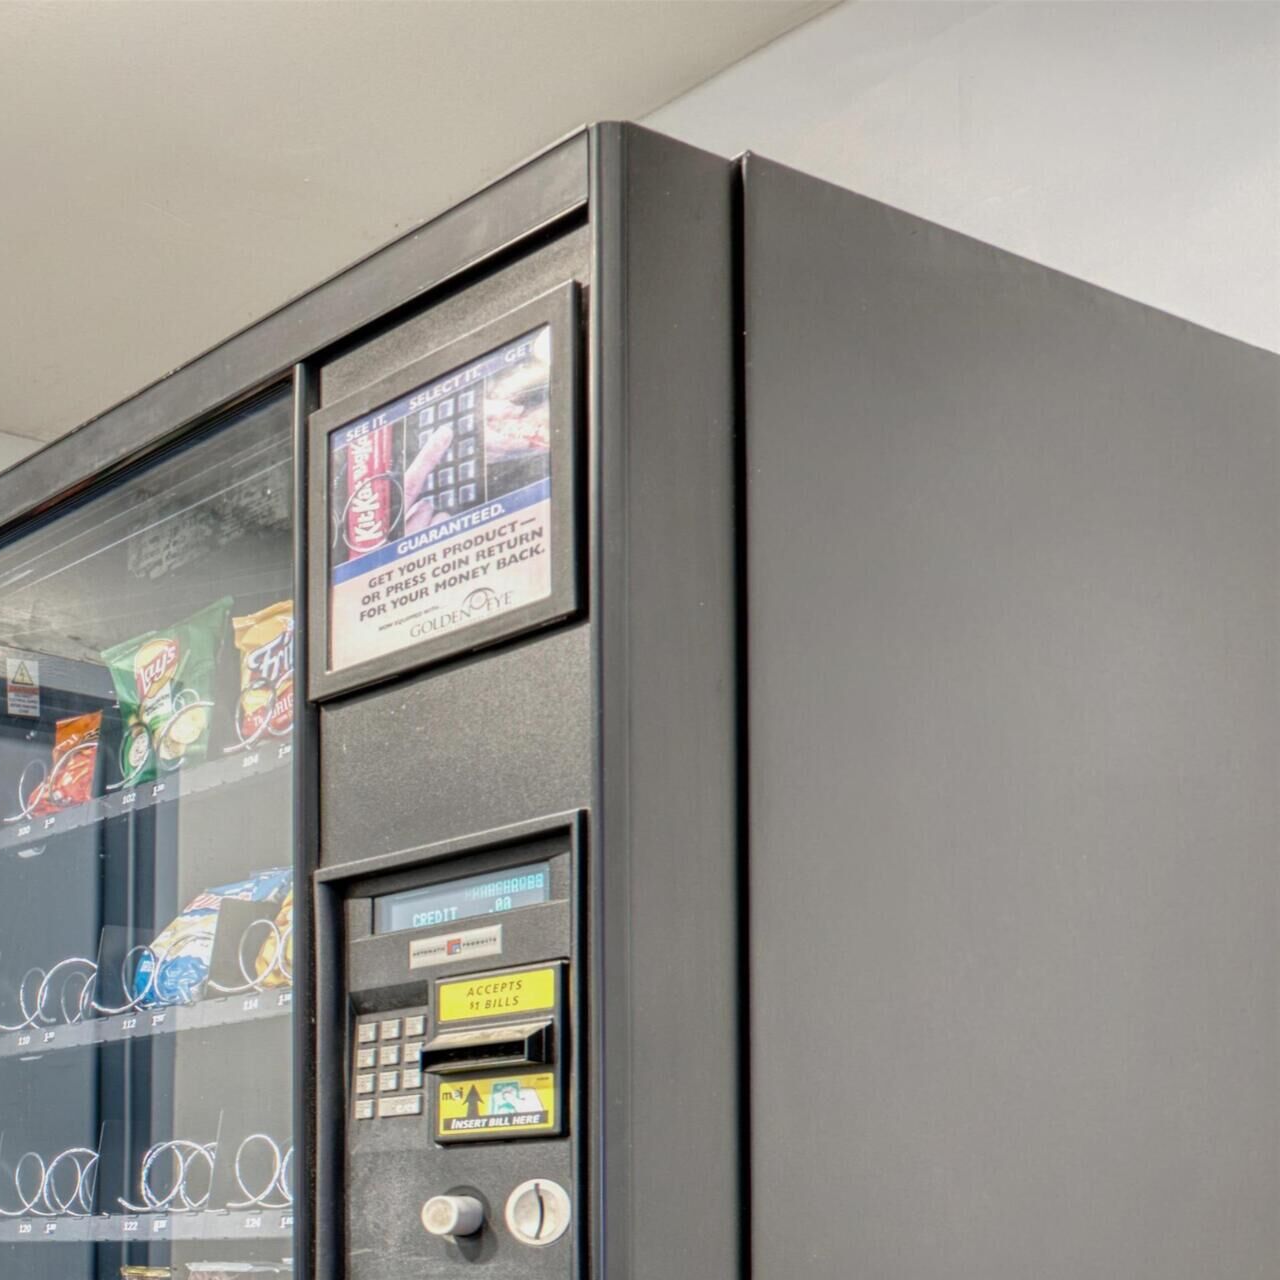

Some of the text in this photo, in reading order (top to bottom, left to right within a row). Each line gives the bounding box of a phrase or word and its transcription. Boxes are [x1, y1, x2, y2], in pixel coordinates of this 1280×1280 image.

[346, 420, 370, 443] SEE
[372, 412, 388, 431] IT.
[408, 374, 465, 412] SELECT
[464, 366, 482, 383] IT.
[396, 503, 506, 555] GUARANTEED.
[361, 526, 544, 606] OR PRESS COIN RETURN
[368, 568, 395, 589] GET
[398, 552, 438, 578] YOUR
[359, 543, 546, 622] FOR YOUR MONEY BACK.
[409, 605, 472, 638] GOLDEN
[413, 906, 458, 928] CREDIT
[467, 979, 523, 997] ACCEPTS
[469, 995, 520, 1011] $1 BILLS
[450, 1113, 541, 1130] INSERT BILL HERE
[19, 1224, 32, 1233] 120
[123, 1220, 138, 1231] 122
